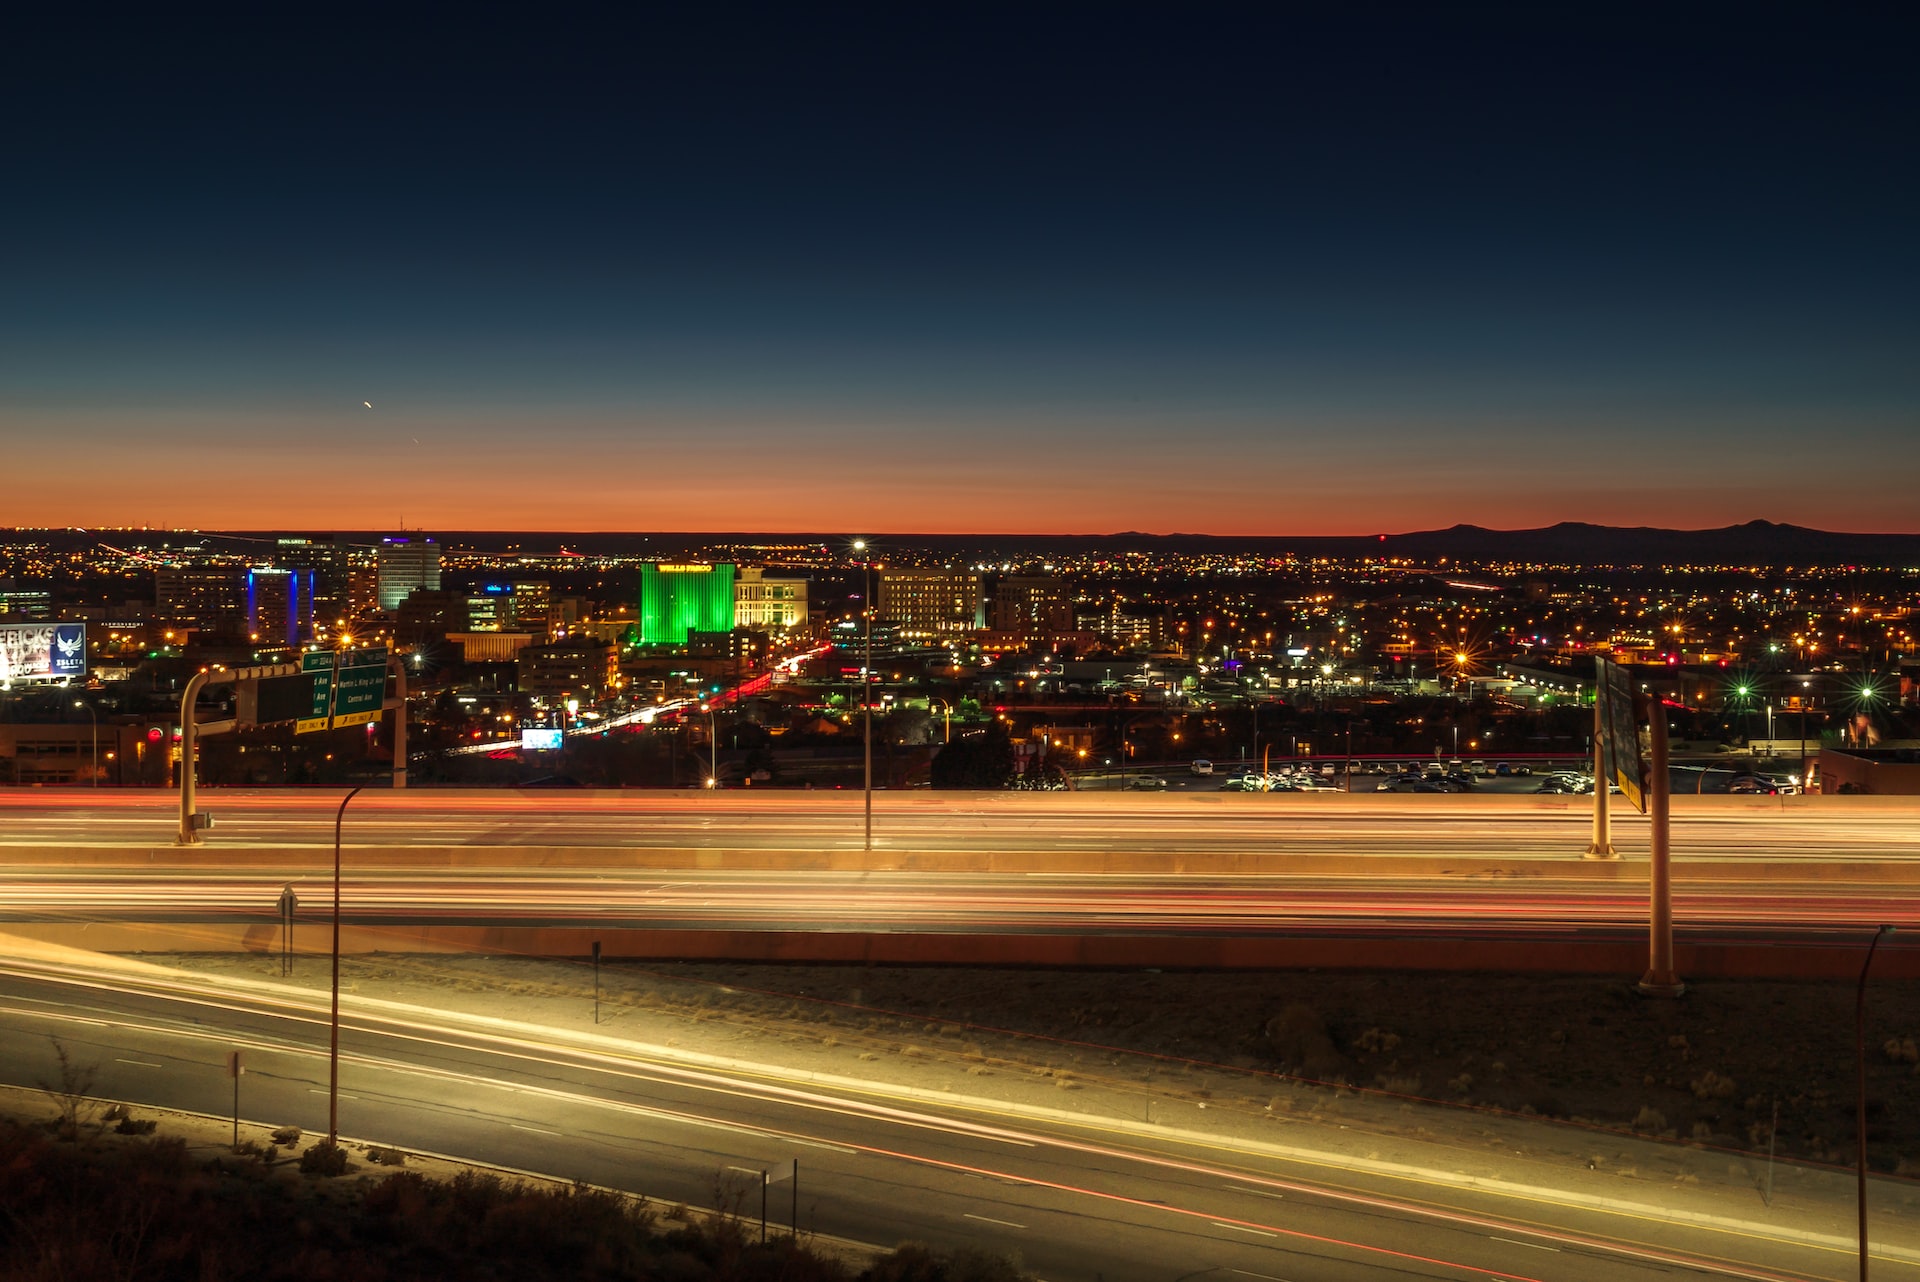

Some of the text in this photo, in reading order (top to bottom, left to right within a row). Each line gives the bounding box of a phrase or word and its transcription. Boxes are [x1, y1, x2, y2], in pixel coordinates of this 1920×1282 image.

[318, 677, 328, 685] Ave
[316, 693, 326, 701] Ave
[347, 694, 373, 703] Central Ave
